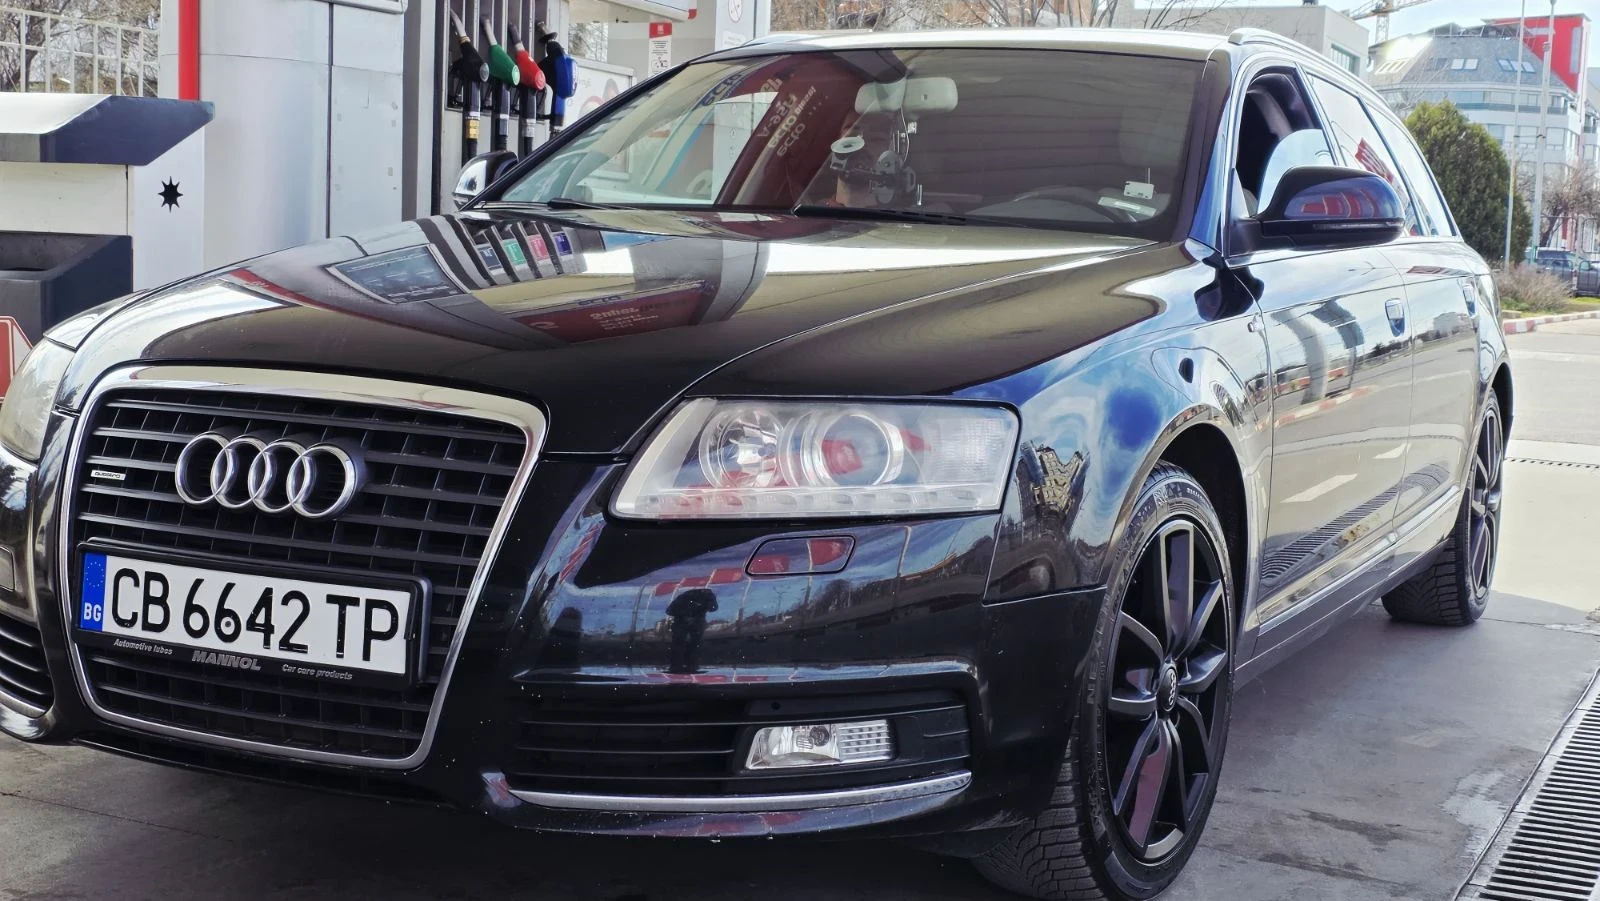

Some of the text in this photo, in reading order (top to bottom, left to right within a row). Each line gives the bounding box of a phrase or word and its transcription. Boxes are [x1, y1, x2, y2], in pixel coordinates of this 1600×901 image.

[83, 602, 102, 622] BG
[111, 567, 399, 661] CB 6642 TP
[113, 639, 173, 655] Automotive lubes
[192, 650, 261, 671] MANNOL
[282, 663, 353, 680] Car care products
